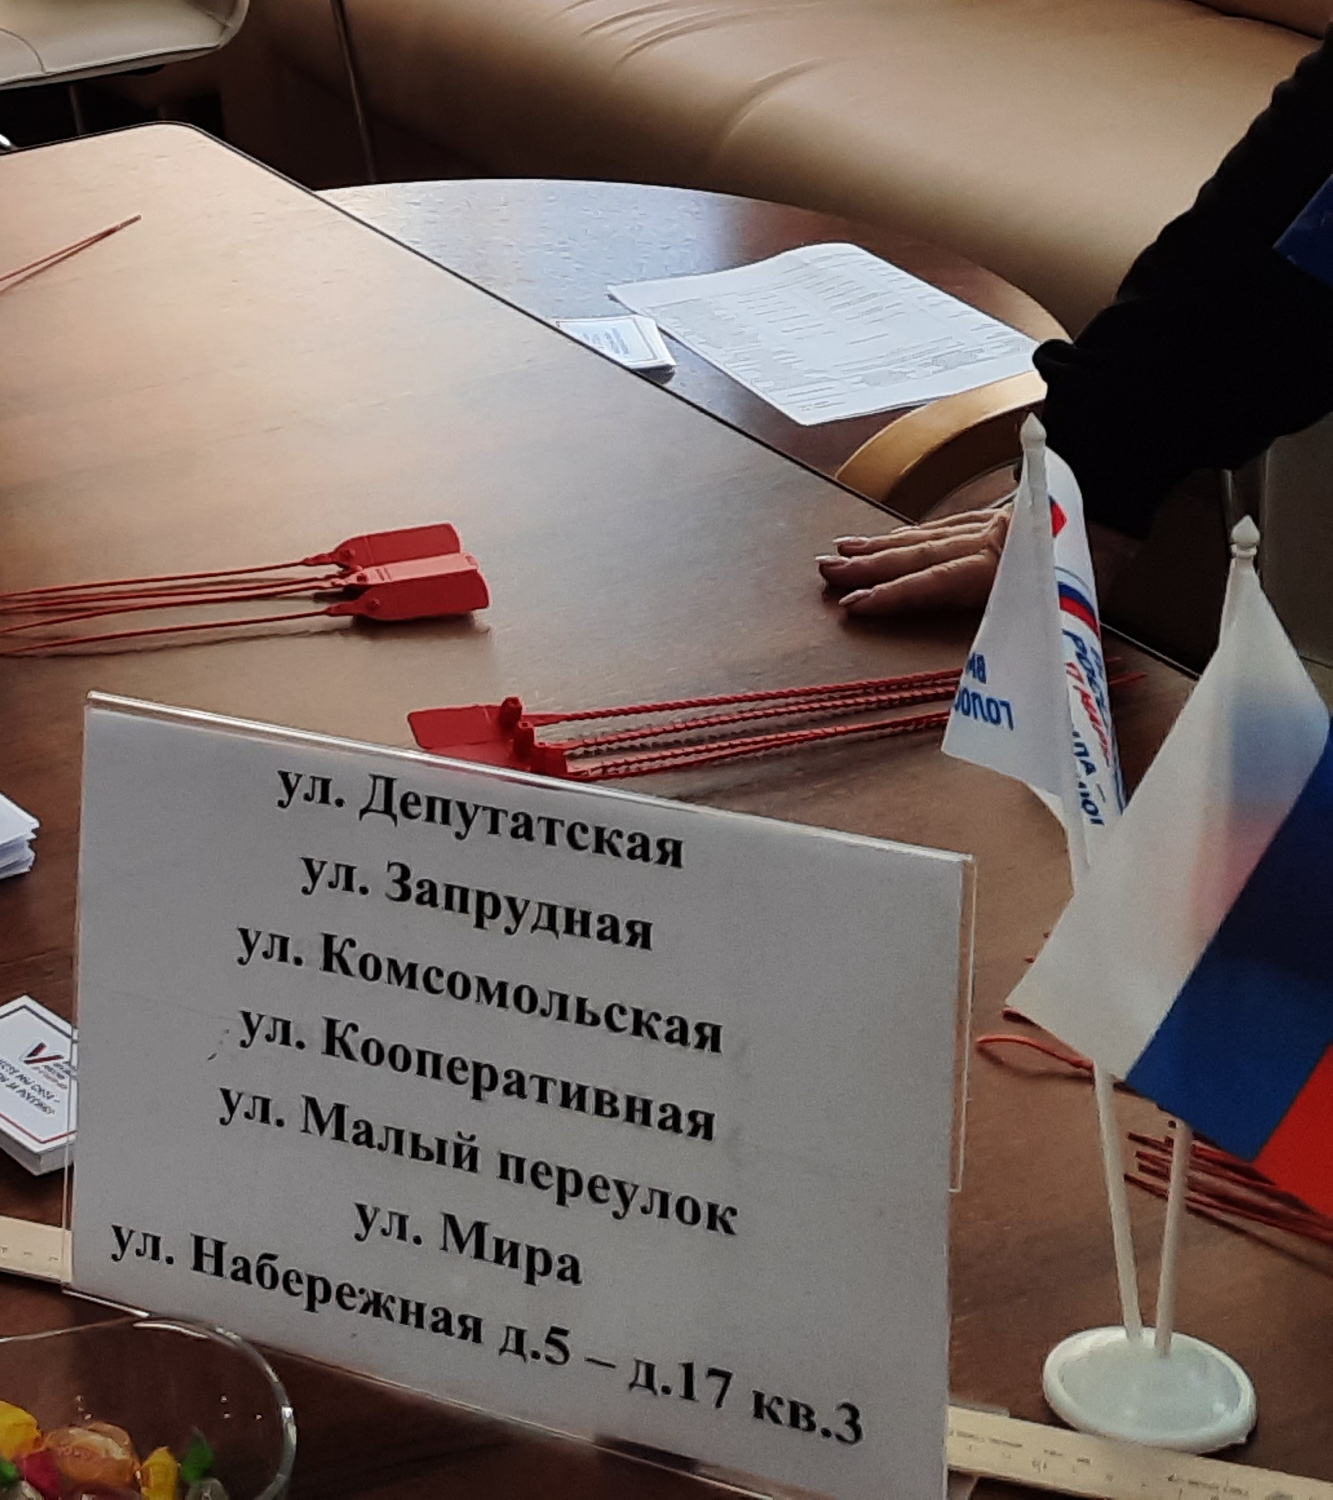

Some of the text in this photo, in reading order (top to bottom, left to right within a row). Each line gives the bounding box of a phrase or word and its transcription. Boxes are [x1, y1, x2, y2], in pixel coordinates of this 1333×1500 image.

[276, 770, 685, 870] ул. Депутатская
[300, 856, 653, 951] ул. Запрудная
[236, 927, 724, 1054] ул. Комсомольская
[238, 1010, 717, 1142] ул. Кооперативная
[219, 1087, 739, 1237] ул. Малый переулок
[353, 1202, 584, 1288] ул. Мира
[111, 1224, 175, 1265] ул.
[190, 1233, 484, 1346] Набережная
[498, 1325, 571, 1367] д.5
[628, 1359, 735, 1411] д.17
[751, 1389, 865, 1447] кв.3
